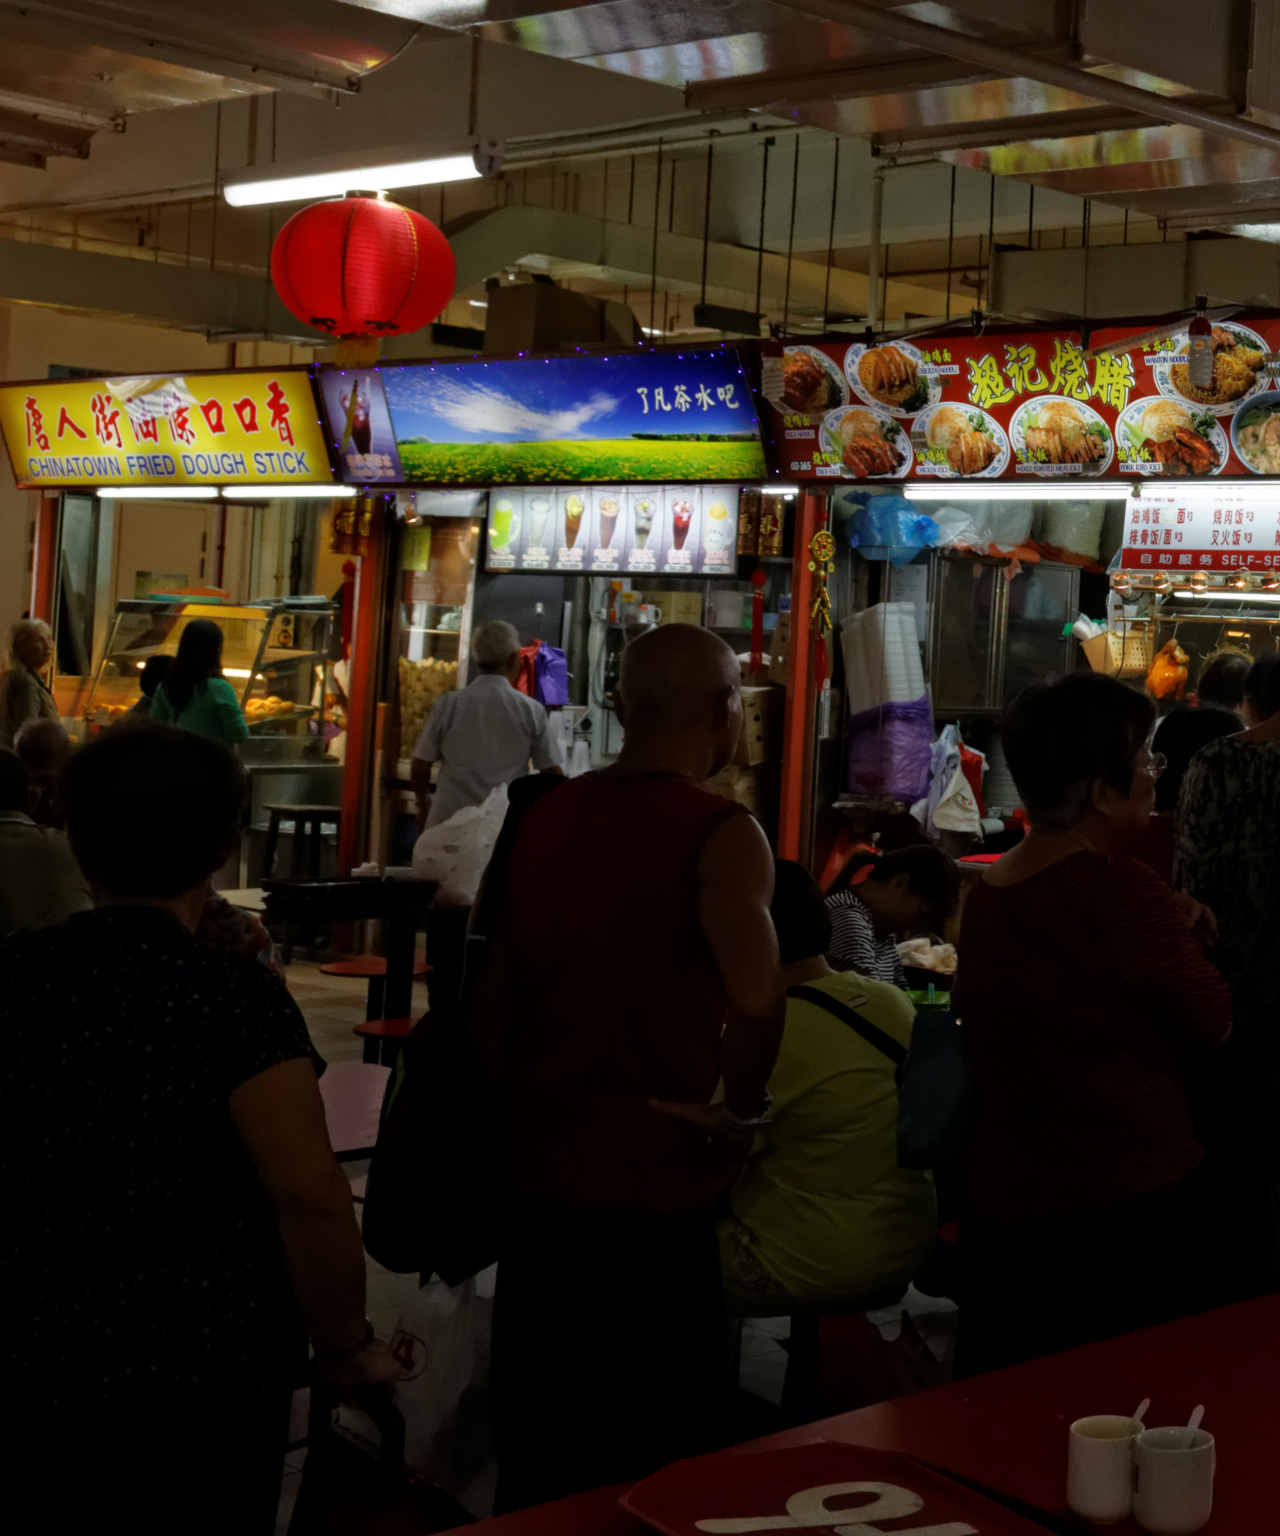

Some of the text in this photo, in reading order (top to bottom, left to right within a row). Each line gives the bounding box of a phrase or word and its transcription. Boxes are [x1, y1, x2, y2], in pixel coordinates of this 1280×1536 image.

[1145, 355, 1168, 364] WANTON
[635, 382, 739, 414] 了凡茶水吧
[28, 451, 311, 478] CHINATOWN FRIED DOUGH STICK
[1069, 463, 1082, 471] RICE
[1120, 463, 1162, 472] PORK RIBS RICE
[1128, 528, 1183, 545] 排骨饭/面 $3
[1244, 532, 1253, 544] $3
[1140, 553, 1213, 566] 自助服务
